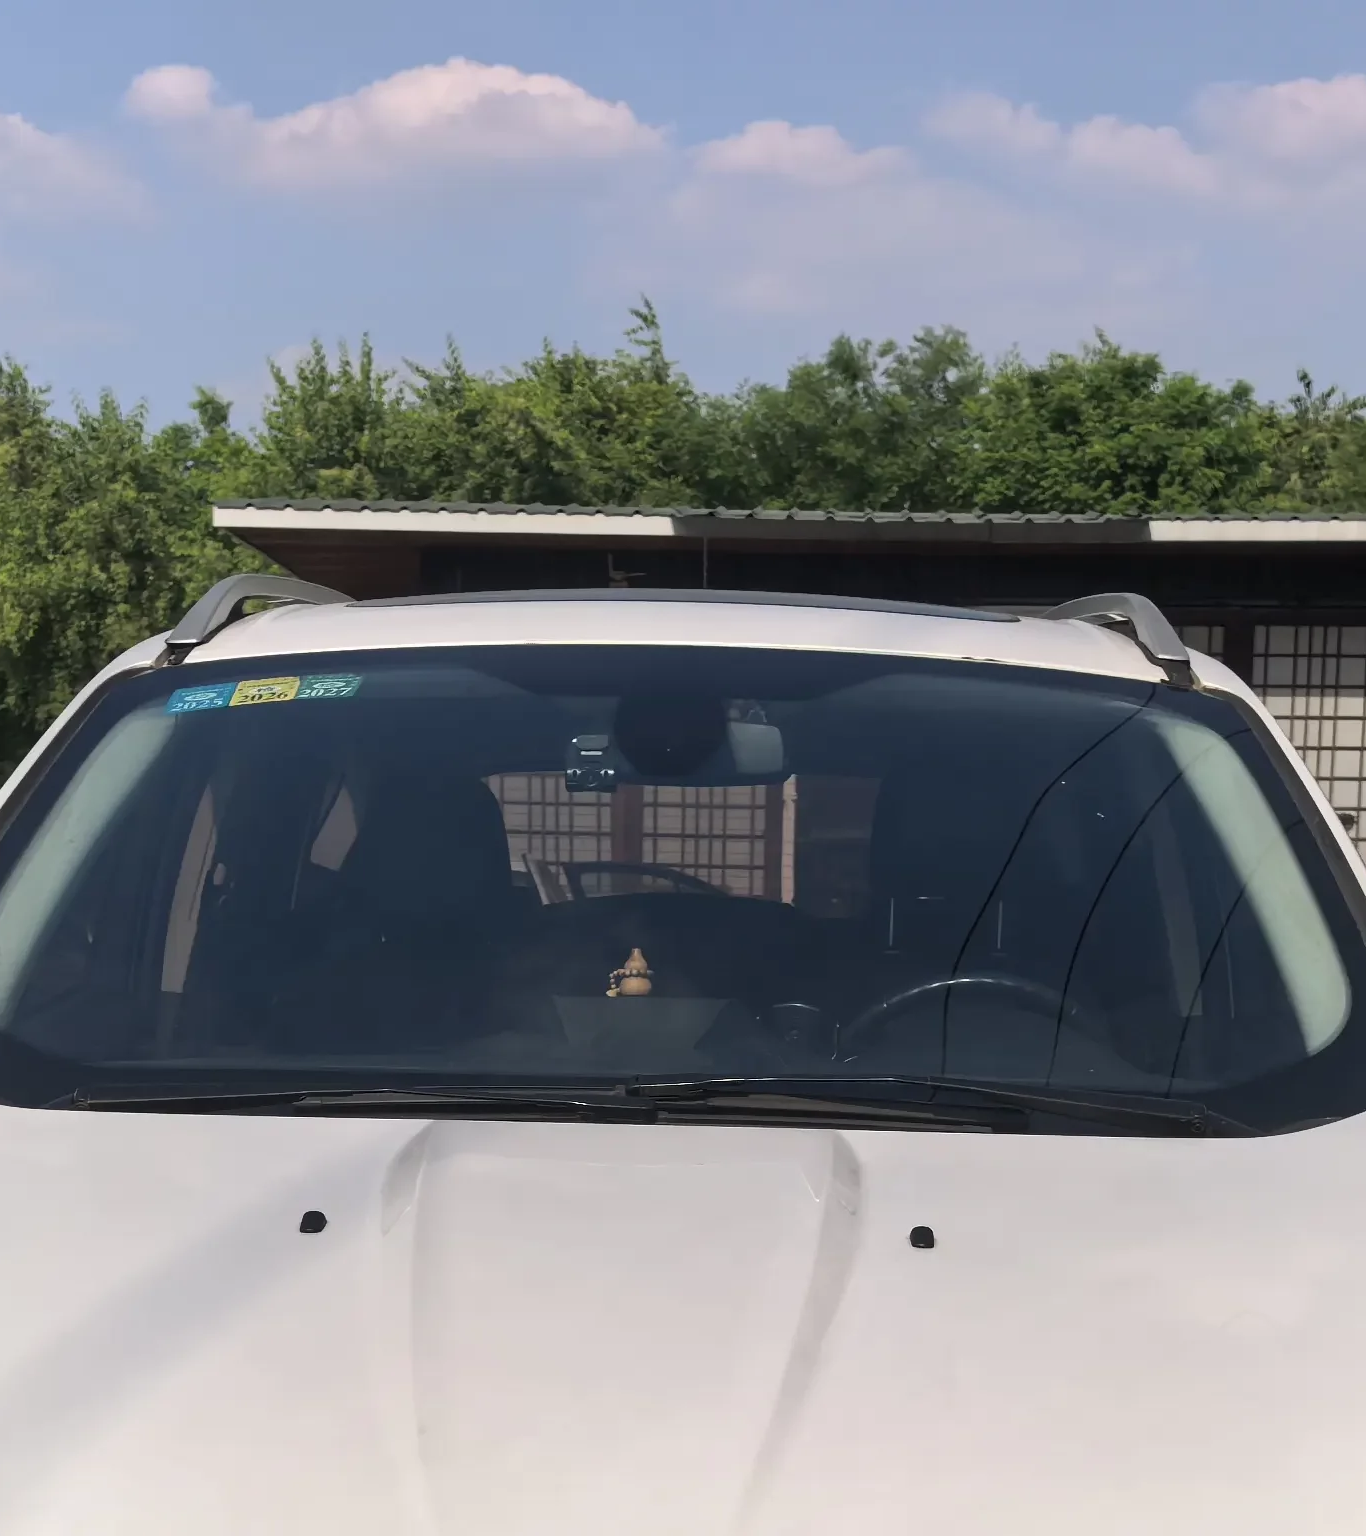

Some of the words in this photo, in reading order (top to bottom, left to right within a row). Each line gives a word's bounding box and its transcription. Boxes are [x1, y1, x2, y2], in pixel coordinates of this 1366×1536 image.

[240, 690, 289, 704] 2026
[297, 687, 350, 699] 2027
[171, 698, 223, 712] 2025
